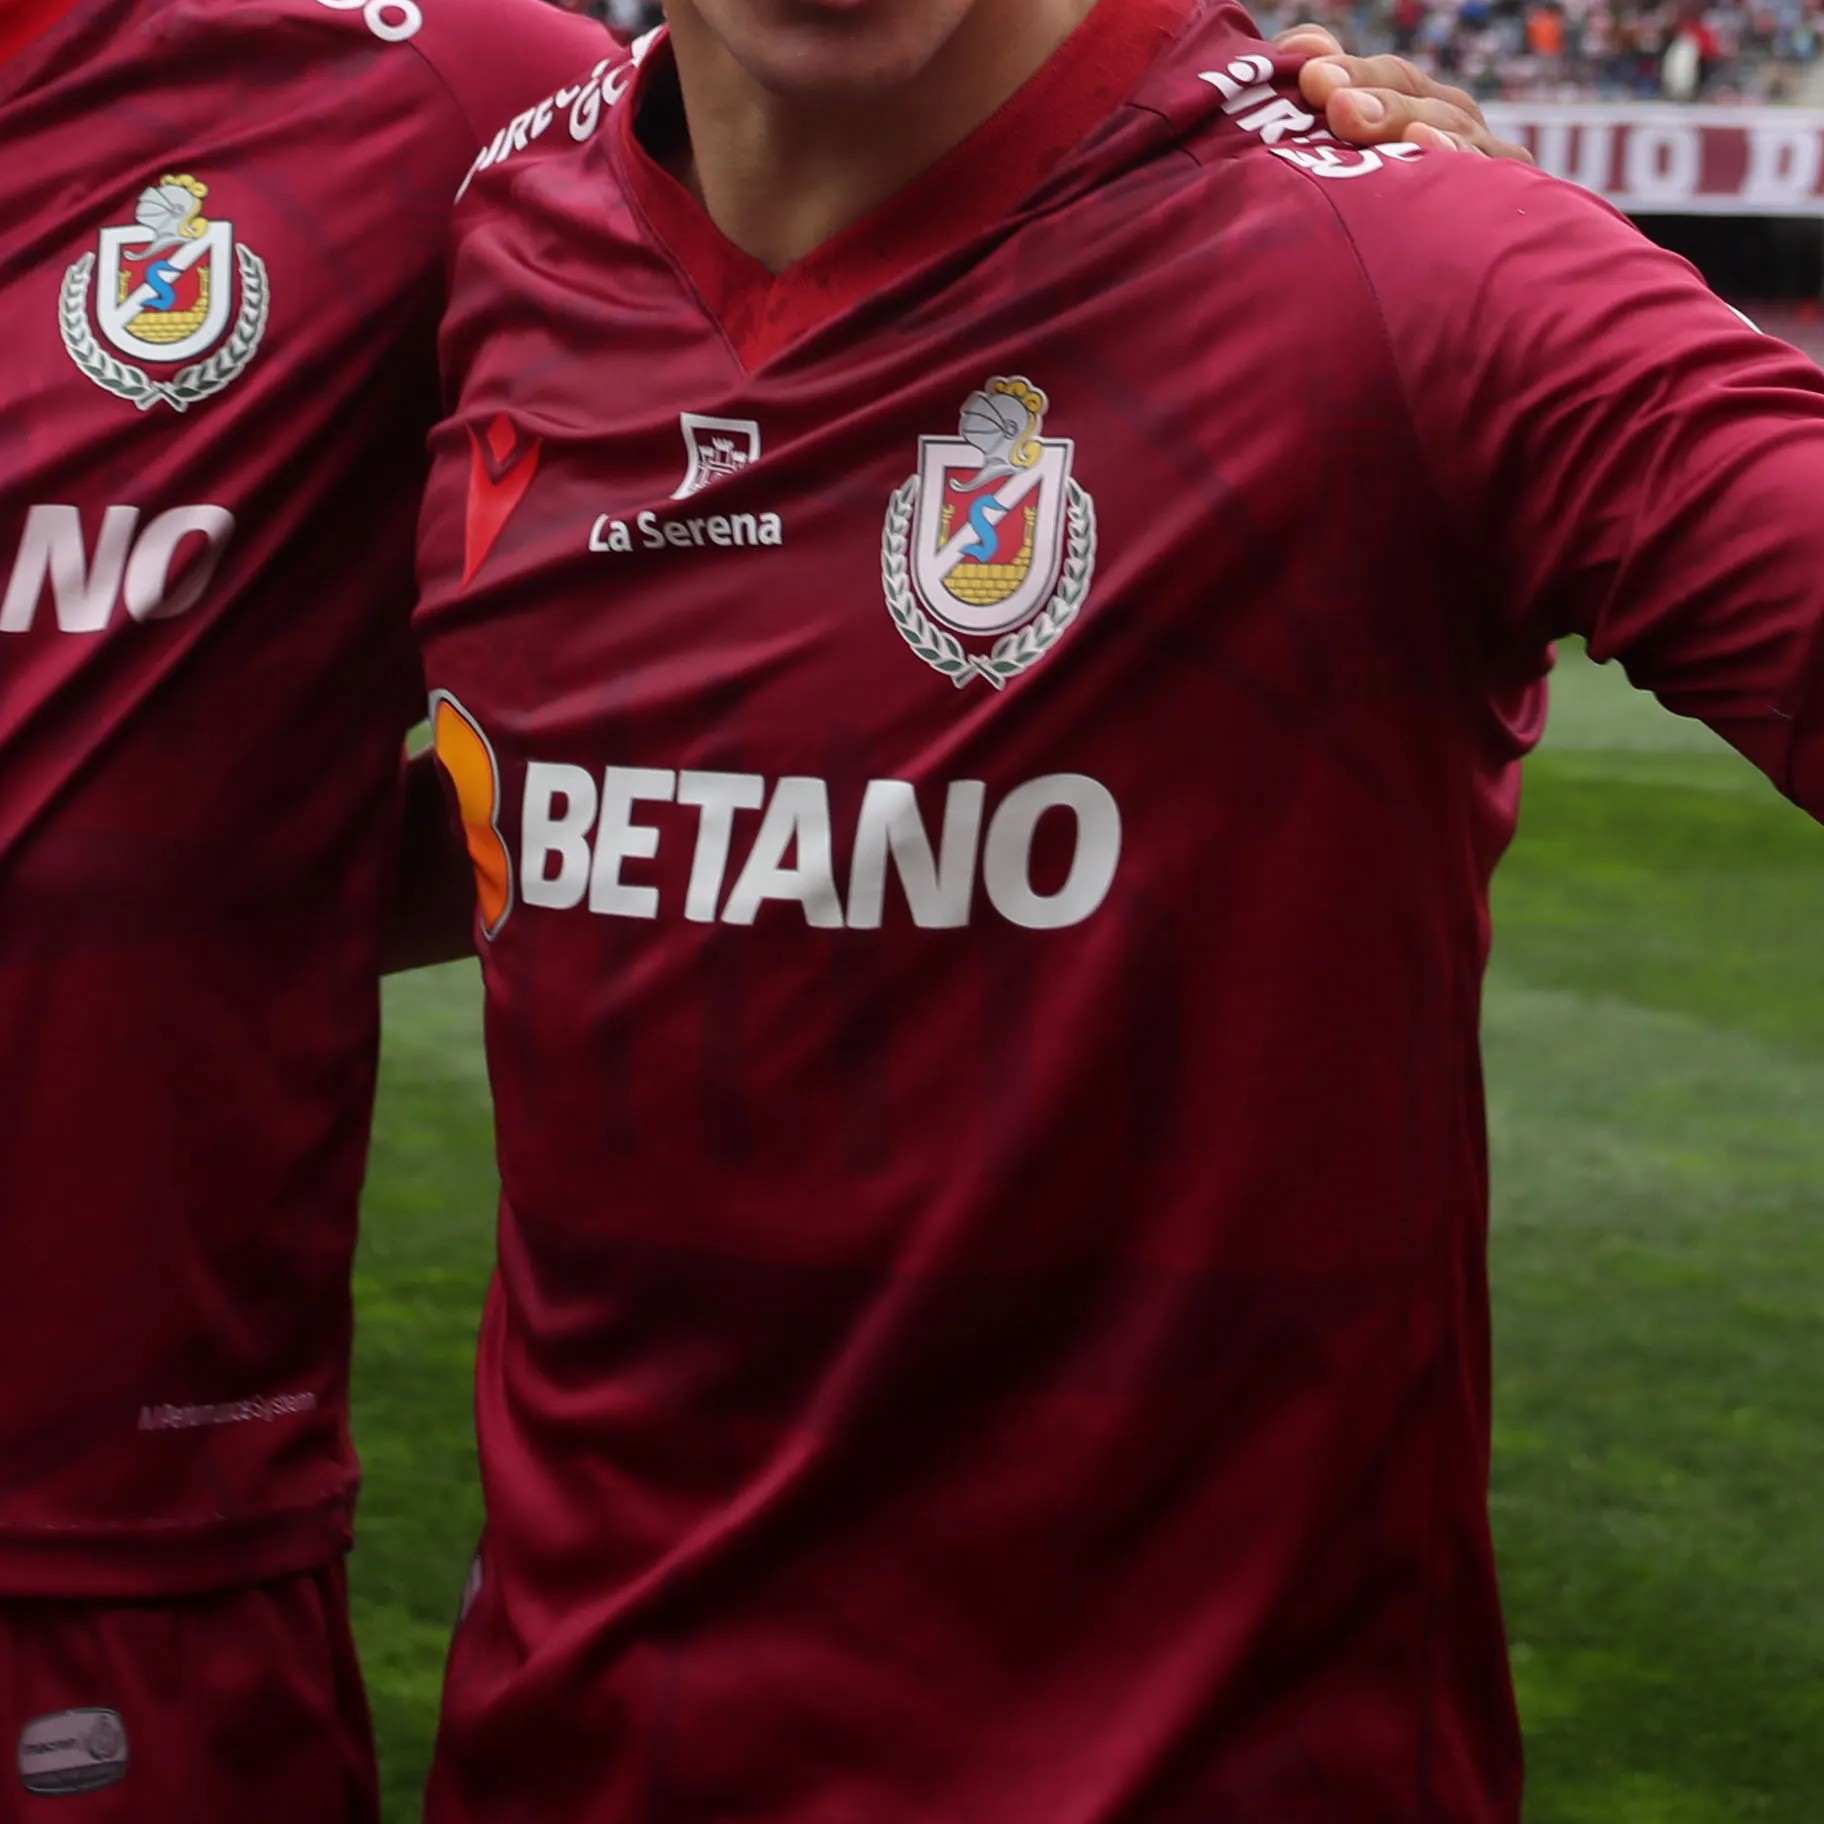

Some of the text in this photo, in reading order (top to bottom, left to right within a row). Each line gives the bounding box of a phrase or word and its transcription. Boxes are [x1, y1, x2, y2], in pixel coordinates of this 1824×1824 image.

[588, 509, 784, 553] La Serena
[521, 760, 1122, 930] BETANO
